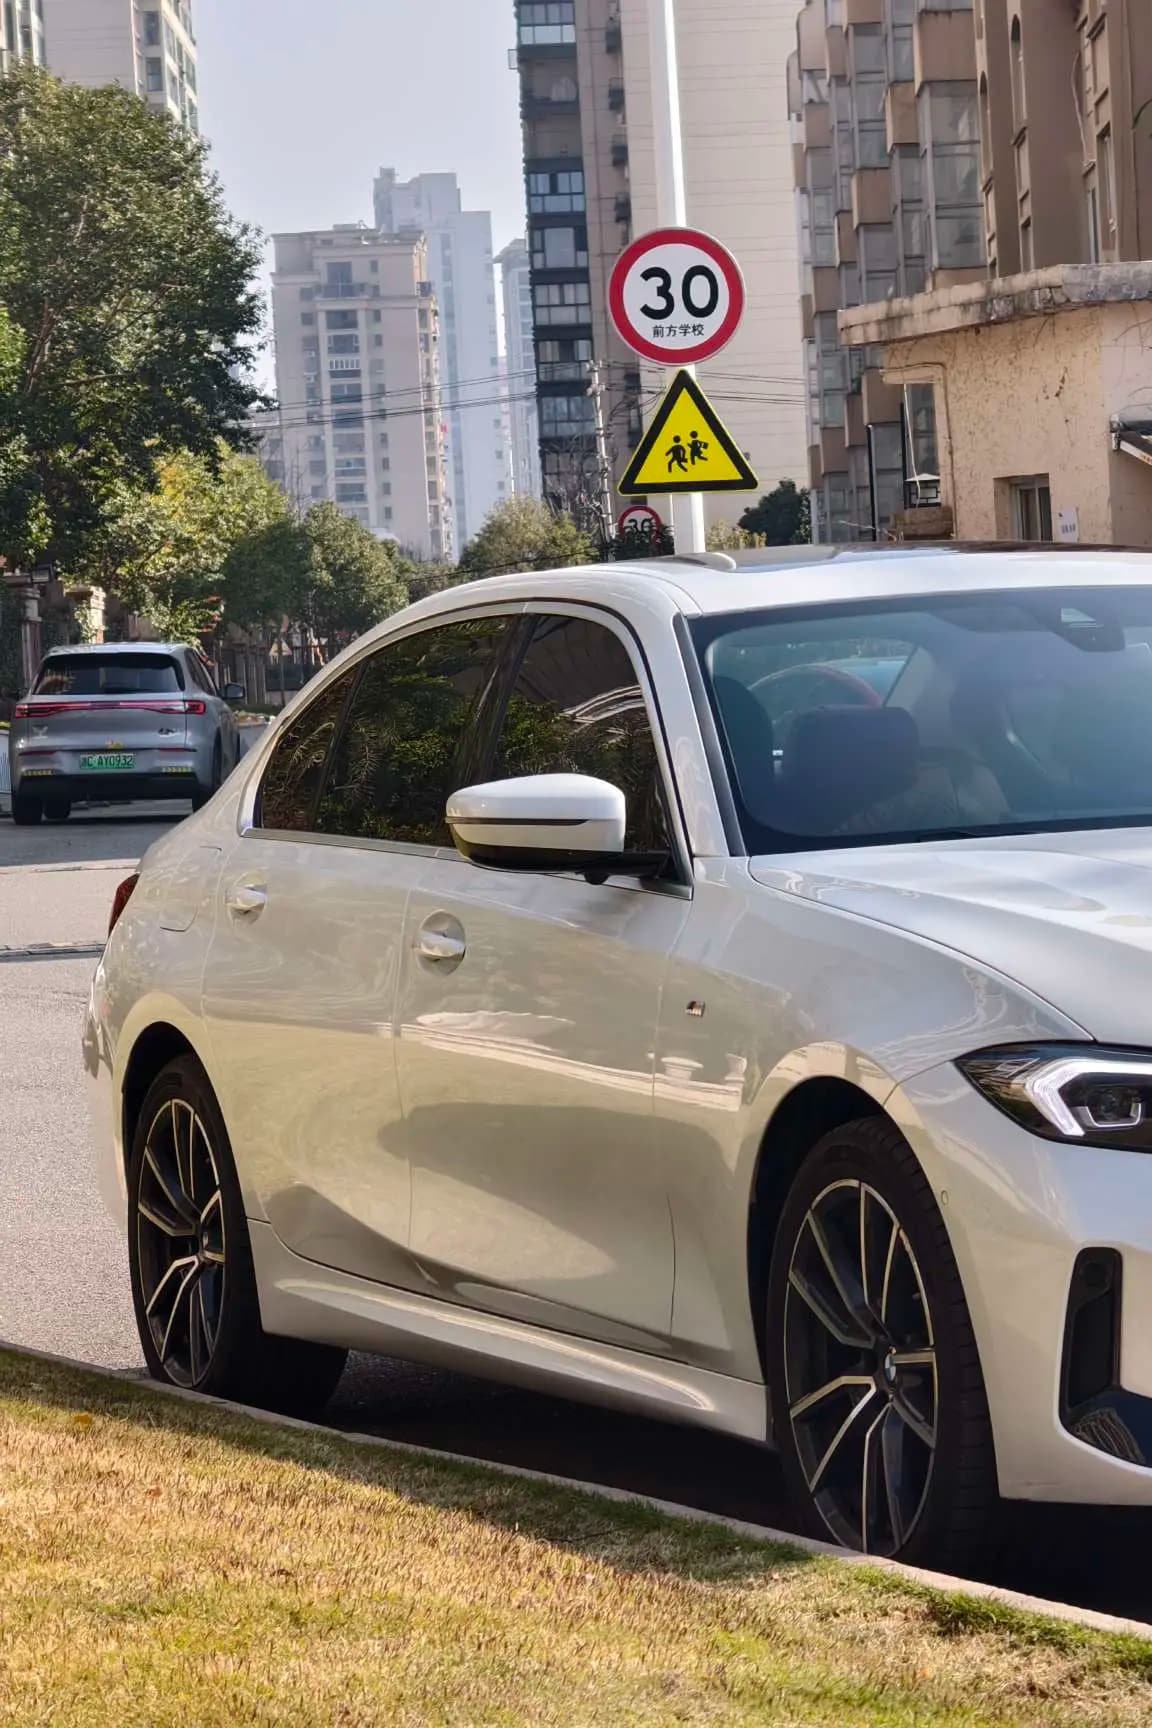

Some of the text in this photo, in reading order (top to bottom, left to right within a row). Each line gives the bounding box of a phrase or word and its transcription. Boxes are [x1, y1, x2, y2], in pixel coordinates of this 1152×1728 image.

[640, 265, 719, 320] 30
[652, 324, 705, 338] 前方学校
